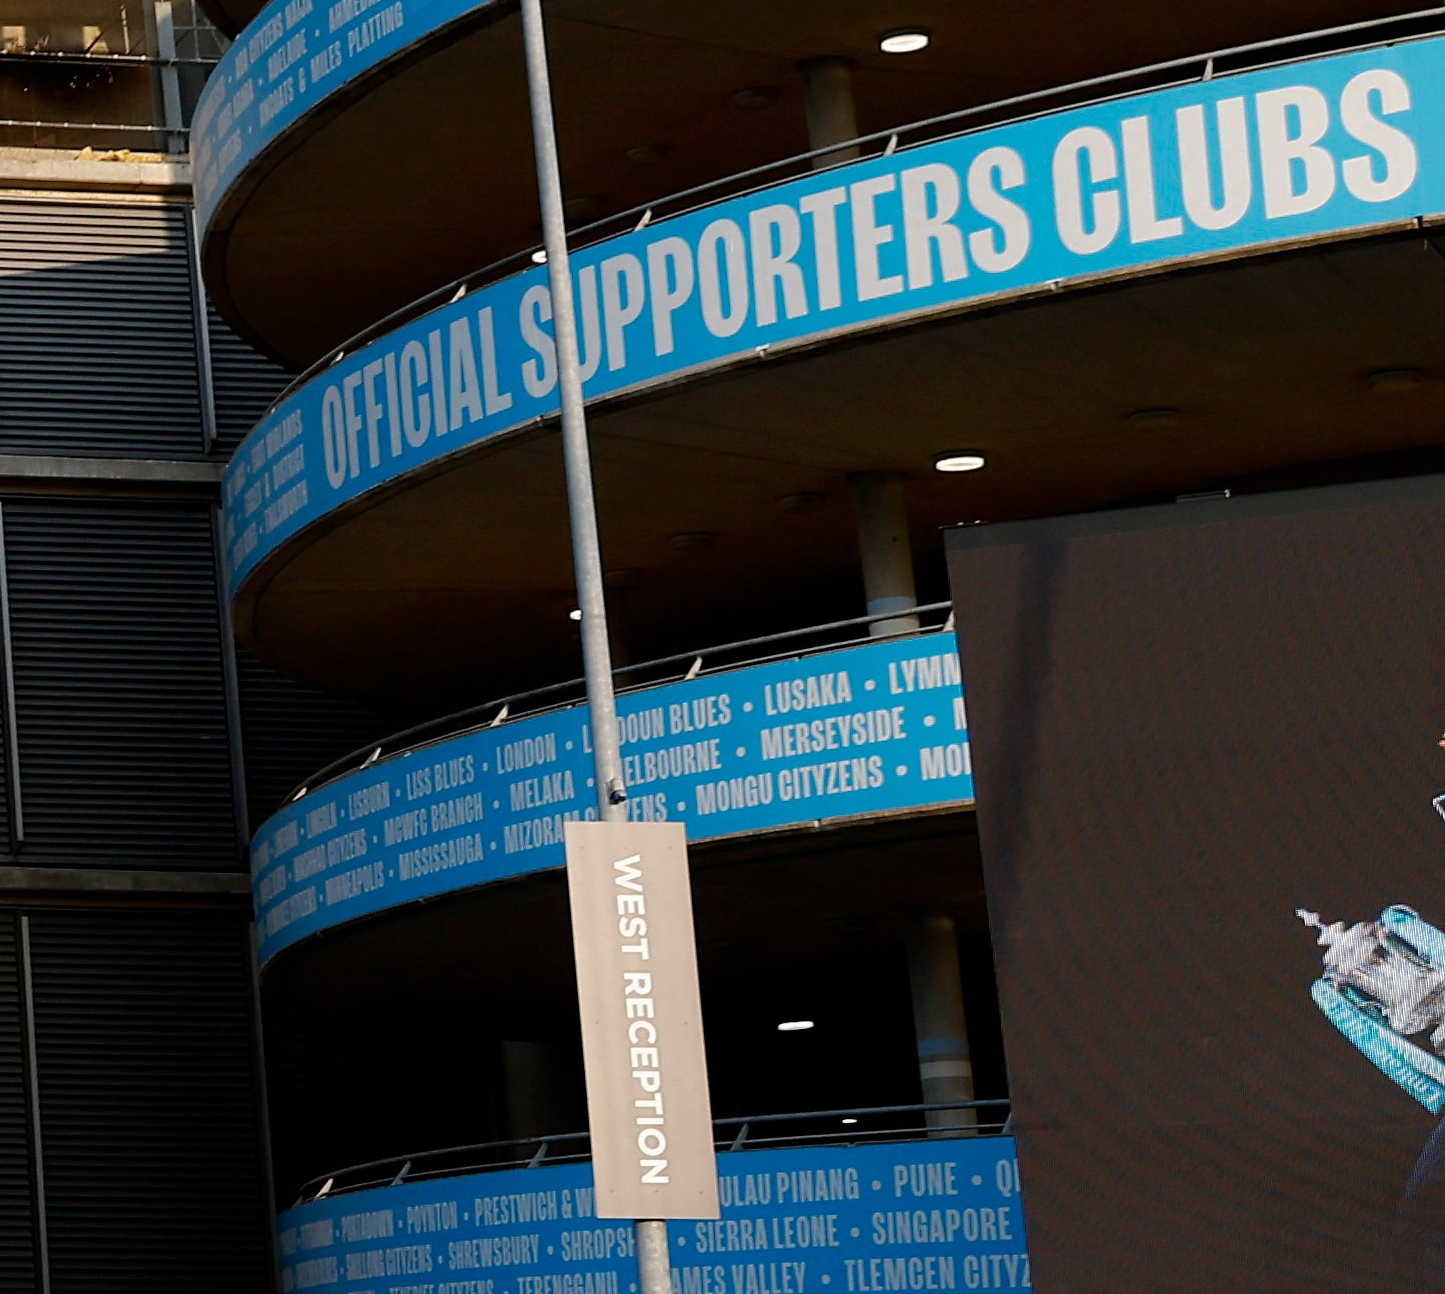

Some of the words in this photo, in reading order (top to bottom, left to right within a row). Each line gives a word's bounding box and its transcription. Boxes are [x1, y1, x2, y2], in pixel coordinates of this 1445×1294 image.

[347, 2, 404, 57] PLATTING
[321, 321, 510, 489] OFFICIAL
[522, 147, 1031, 398] SUPPORTERS
[1051, 69, 1418, 255] CLUBS
[406, 768, 431, 801] LISS
[434, 754, 474, 796] BLUES
[496, 732, 556, 775] LONDON
[670, 693, 732, 736] BLUES
[765, 670, 852, 716] LUSAKA
[430, 792, 483, 832] BRANCH
[509, 770, 574, 812] MELAKA
[760, 707, 906, 759] MERSEYSIDE
[398, 833, 484, 882] MISSISSAUGA
[695, 772, 773, 815] MONGU
[778, 755, 884, 802] CITYZENS
[613, 854, 650, 961] WEST
[623, 972, 670, 1184] RECEPTION
[407, 1201, 458, 1234] POYNTON
[475, 1190, 557, 1226] PRESTWICH
[776, 1167, 860, 1204] PINANG
[893, 1162, 958, 1198] PUNE
[448, 1234, 539, 1270] SHREWSBURY
[695, 1217, 768, 1253] SIERRA
[772, 1214, 840, 1249] LEONE
[872, 1207, 1013, 1246] SINGAPORE
[844, 1255, 956, 1292] TLEMCEN
